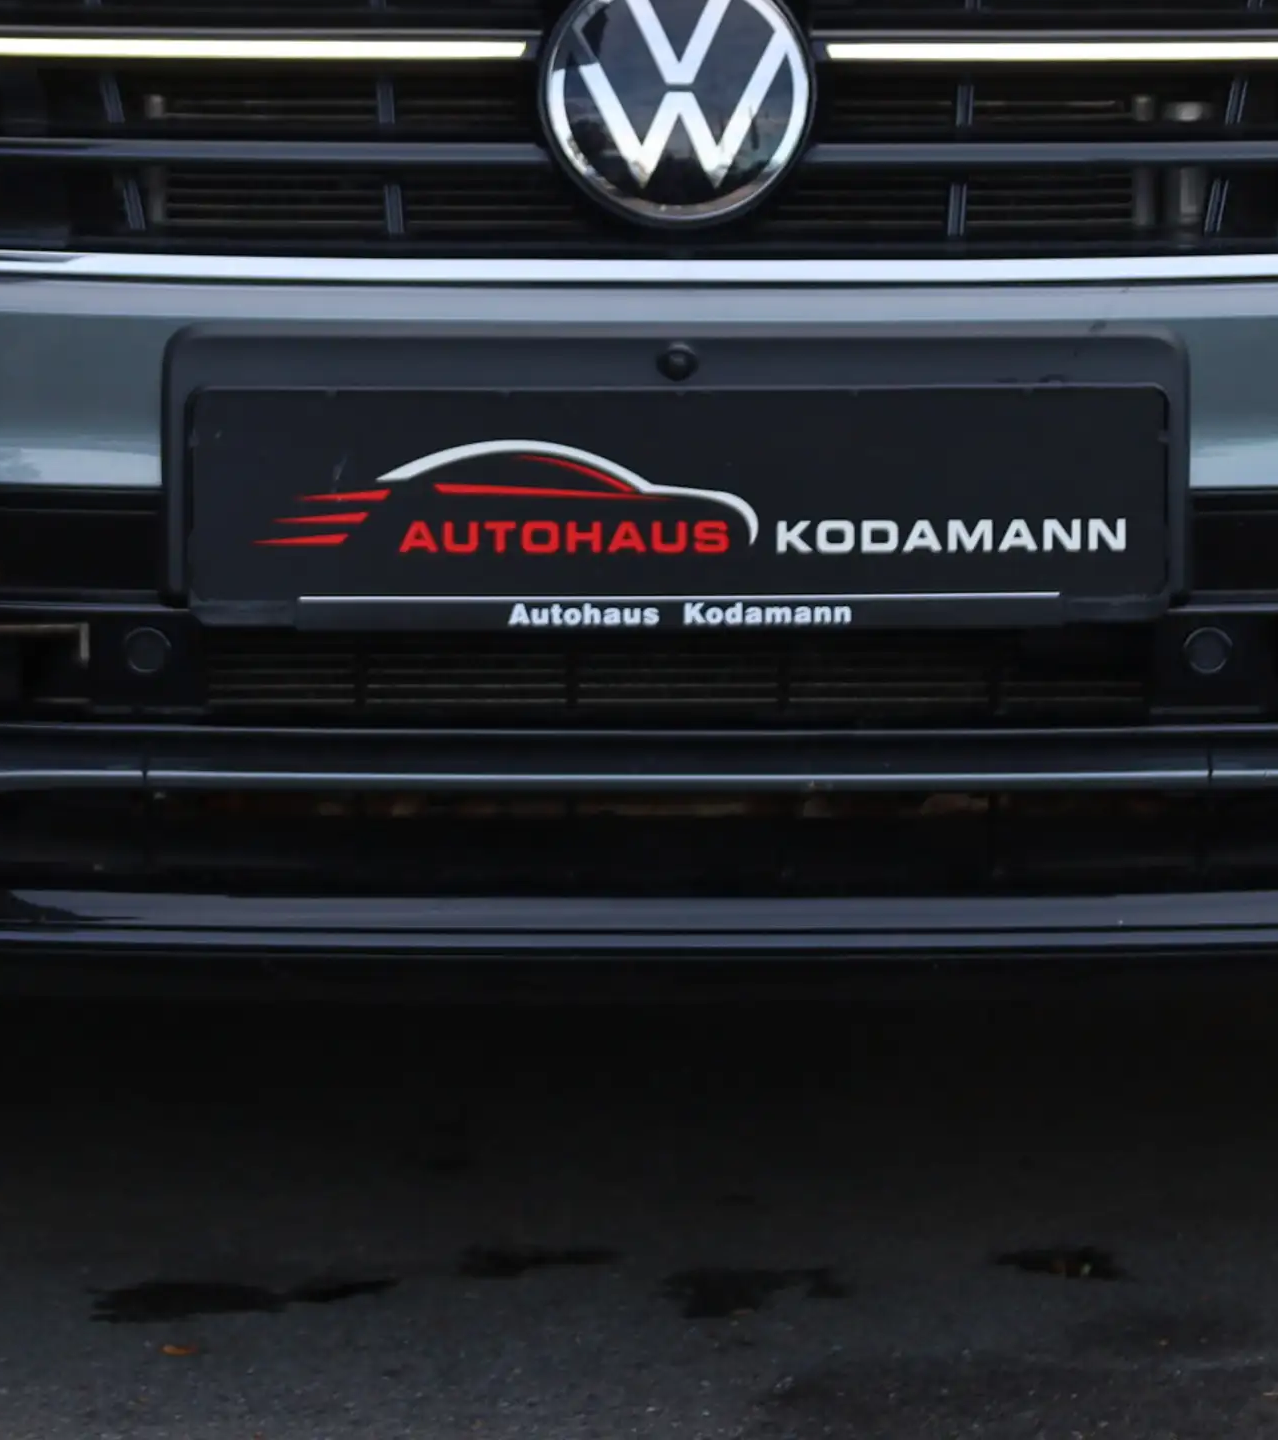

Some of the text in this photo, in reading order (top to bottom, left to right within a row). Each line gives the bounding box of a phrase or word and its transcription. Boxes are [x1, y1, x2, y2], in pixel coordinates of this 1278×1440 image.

[399, 518, 1127, 554] AUTOHAUS KODAMANN
[508, 601, 853, 626] Autohaus Kodamann
